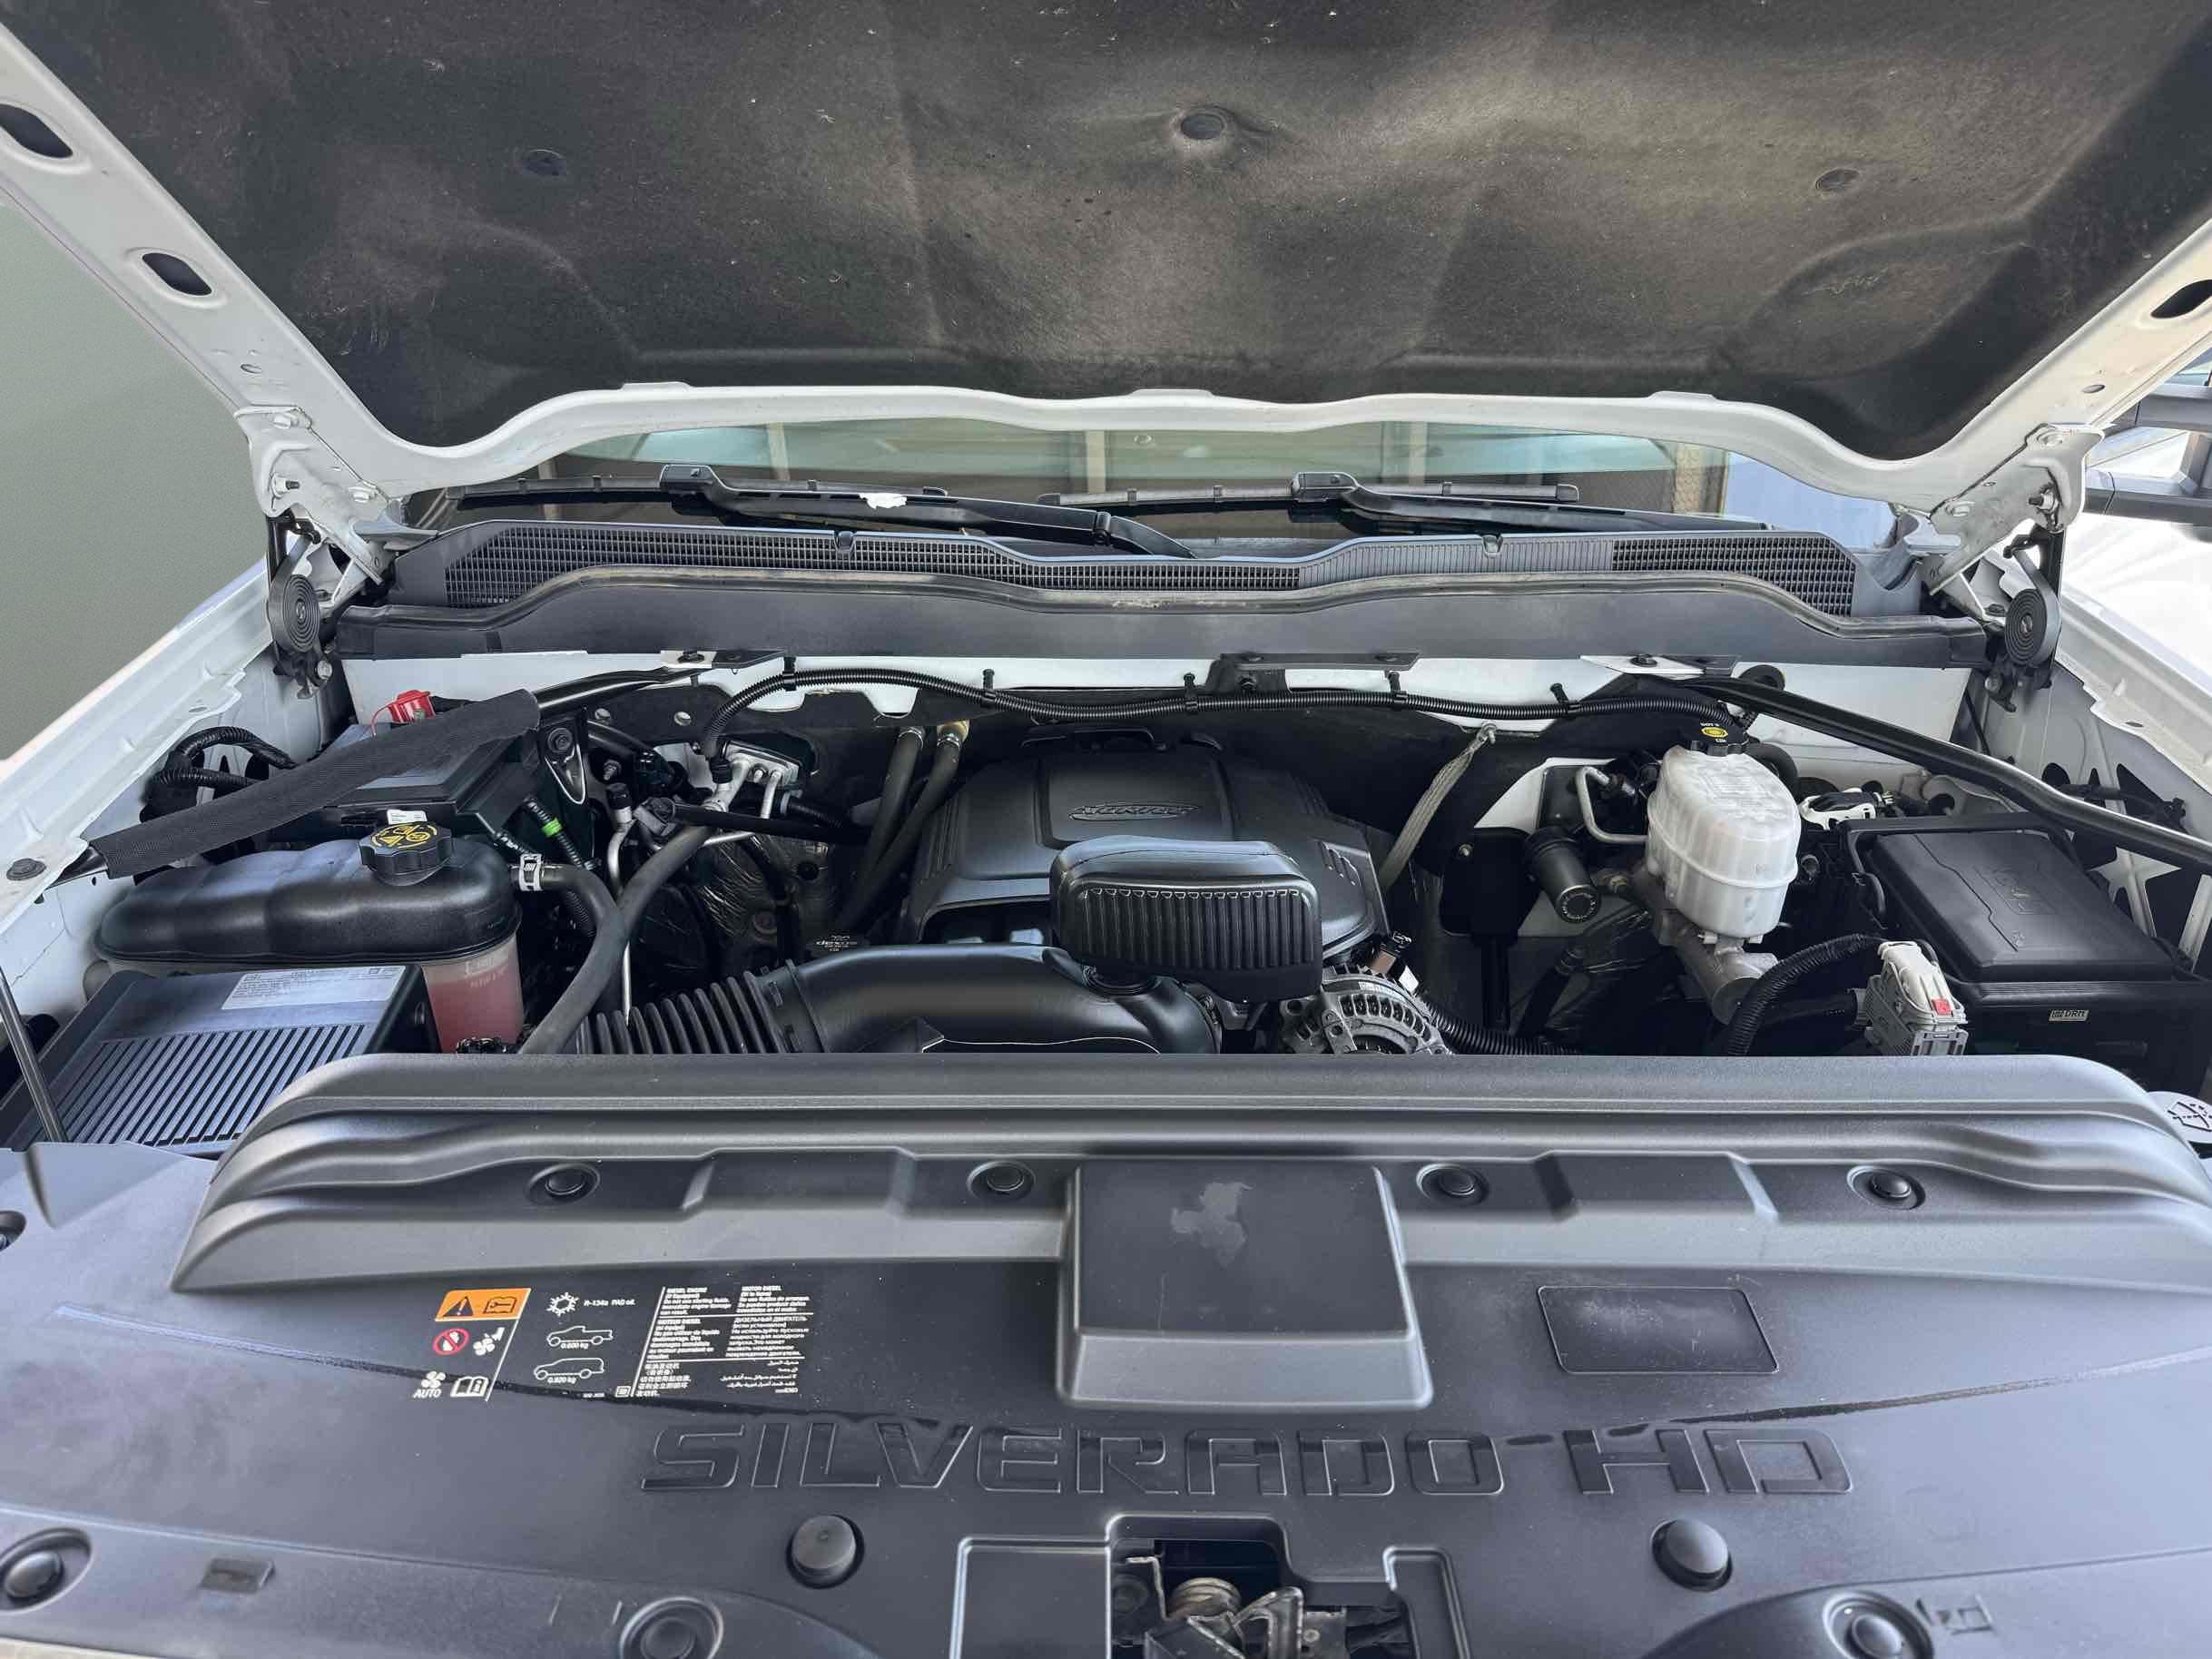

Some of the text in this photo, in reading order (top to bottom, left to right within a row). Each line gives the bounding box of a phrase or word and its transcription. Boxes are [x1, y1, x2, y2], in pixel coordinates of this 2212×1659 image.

[412, 1388, 442, 1399] AUTO
[640, 1423, 1854, 1497] SILVERADO HD
